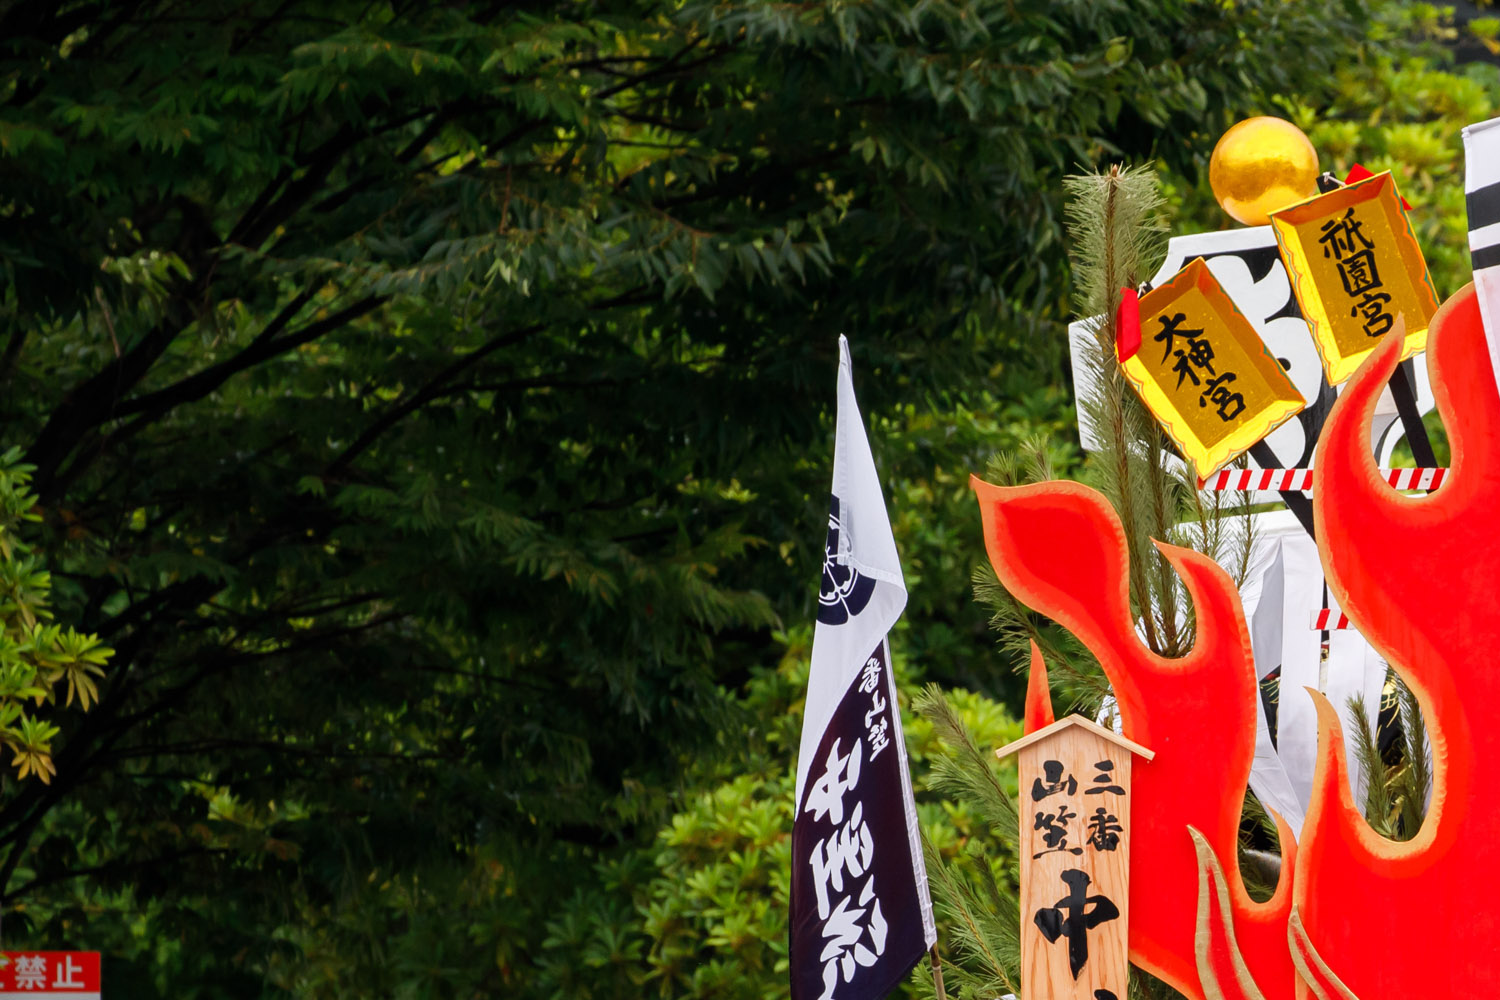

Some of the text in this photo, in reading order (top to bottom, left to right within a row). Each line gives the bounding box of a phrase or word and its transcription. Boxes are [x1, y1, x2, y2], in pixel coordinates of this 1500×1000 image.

[1317, 206, 1394, 338] 祇園宮
[1153, 311, 1247, 422] 大神宮
[1031, 759, 1084, 860] 山笠
[1084, 759, 1127, 853] 三番
[0, 954, 86, 989] 禁止
